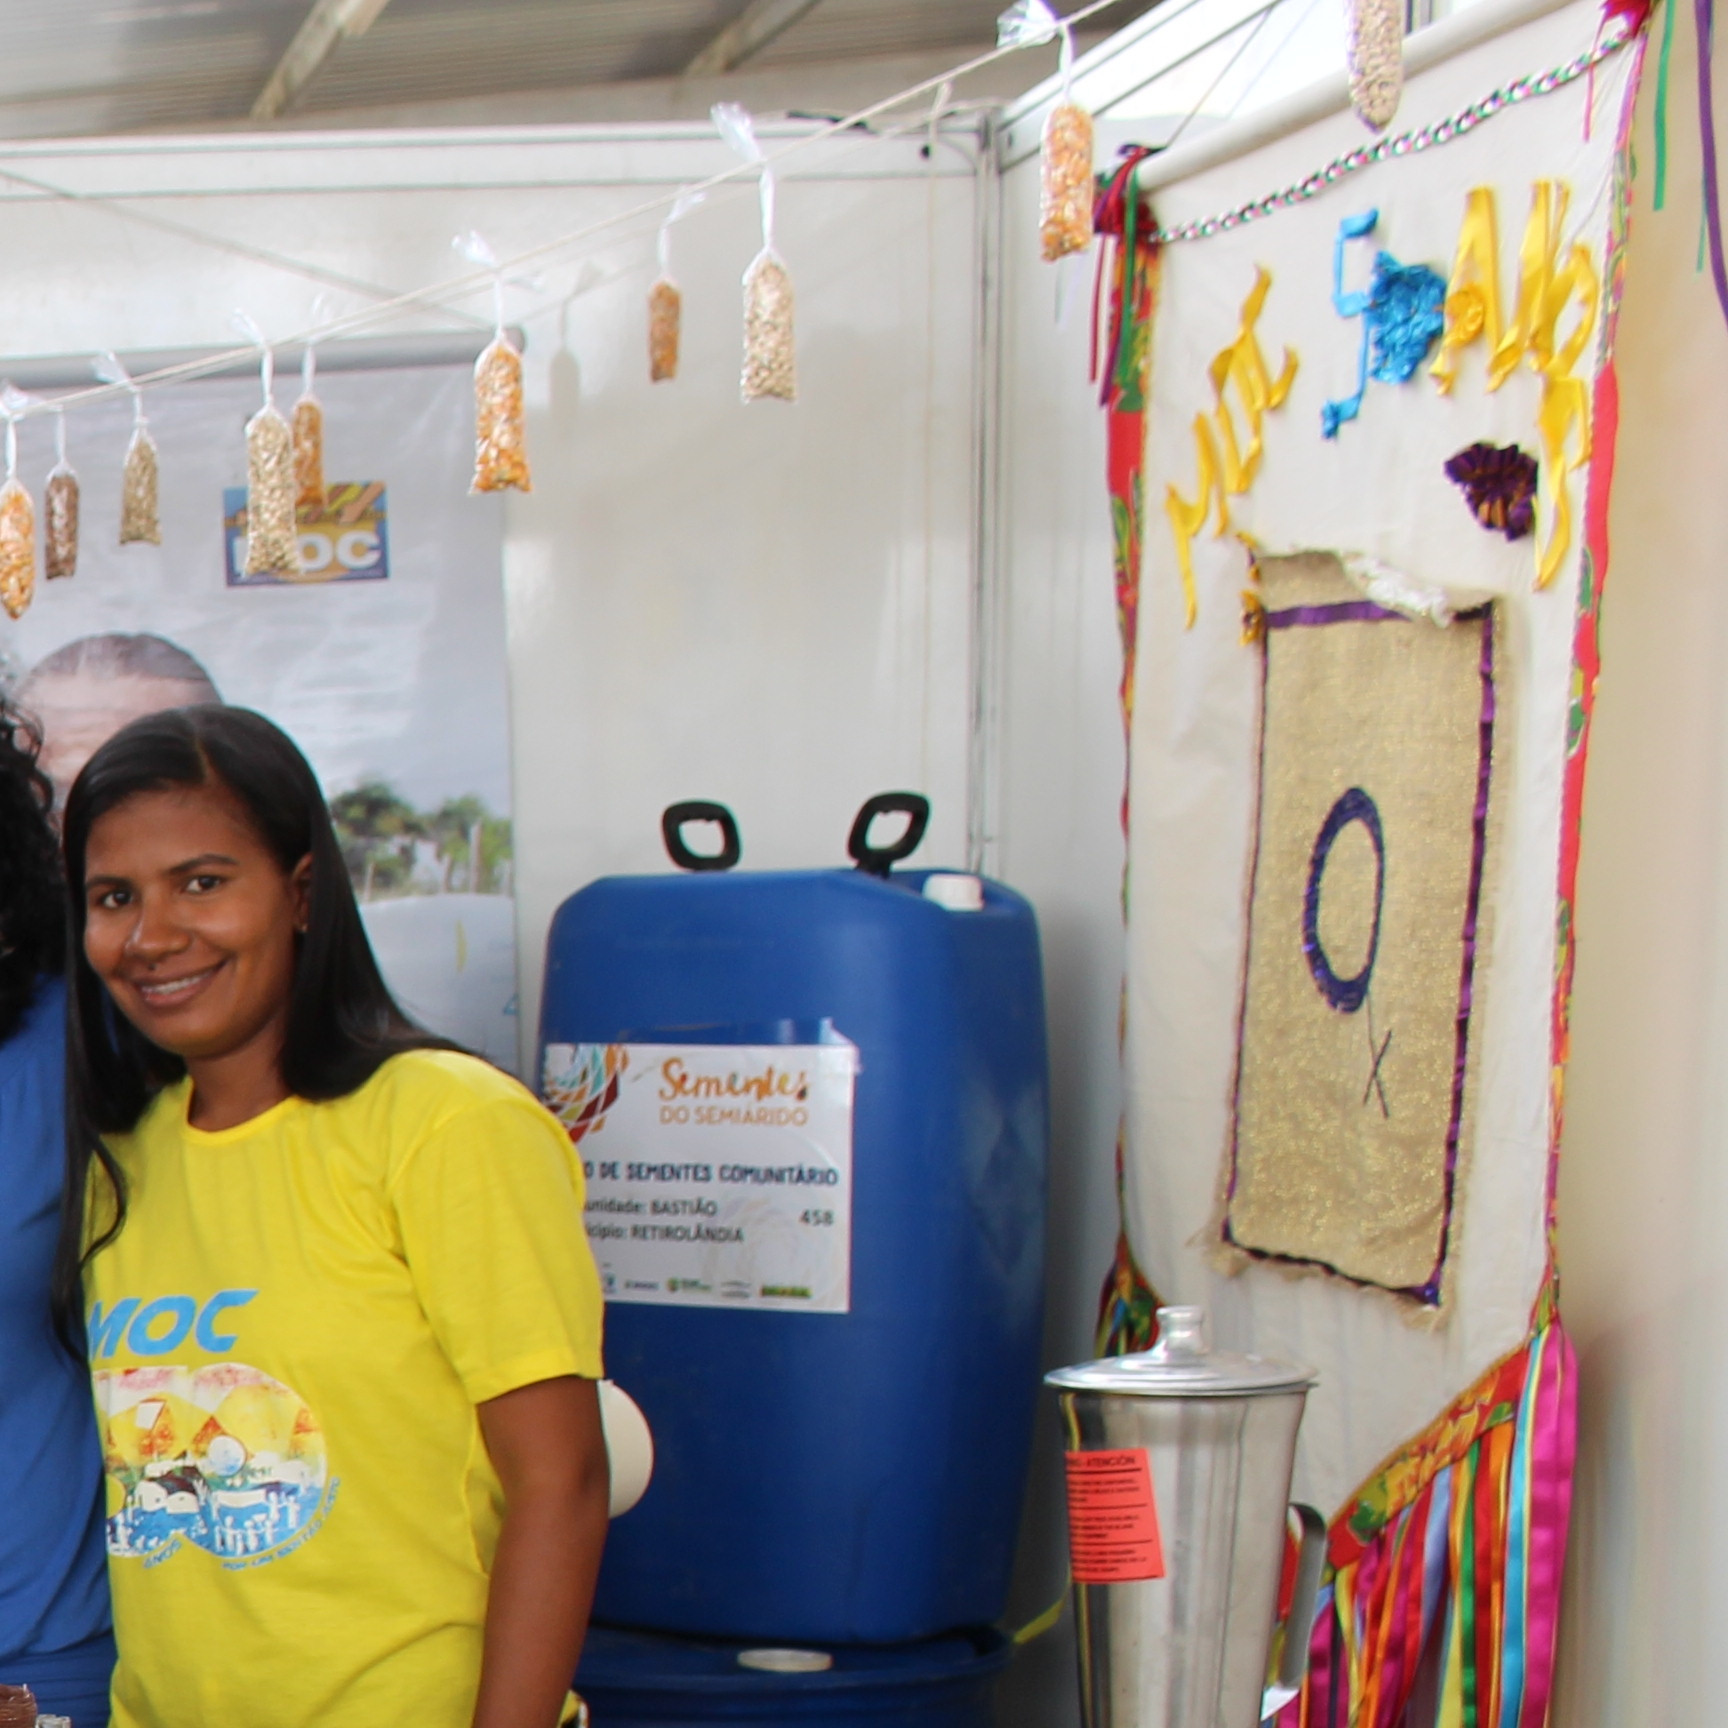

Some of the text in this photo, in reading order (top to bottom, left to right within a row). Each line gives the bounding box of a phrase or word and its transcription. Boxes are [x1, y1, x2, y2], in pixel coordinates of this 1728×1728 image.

[659, 1057, 809, 1102] Sementes
[659, 1105, 690, 1125] DO
[600, 1161, 619, 1180] DE
[627, 1163, 712, 1182] SEMENTES
[719, 1161, 838, 1186] COMUNITÁRIO
[651, 1199, 717, 1217] BASTIÃO
[800, 1209, 834, 1226] 458
[88, 1289, 259, 1360] MOC
